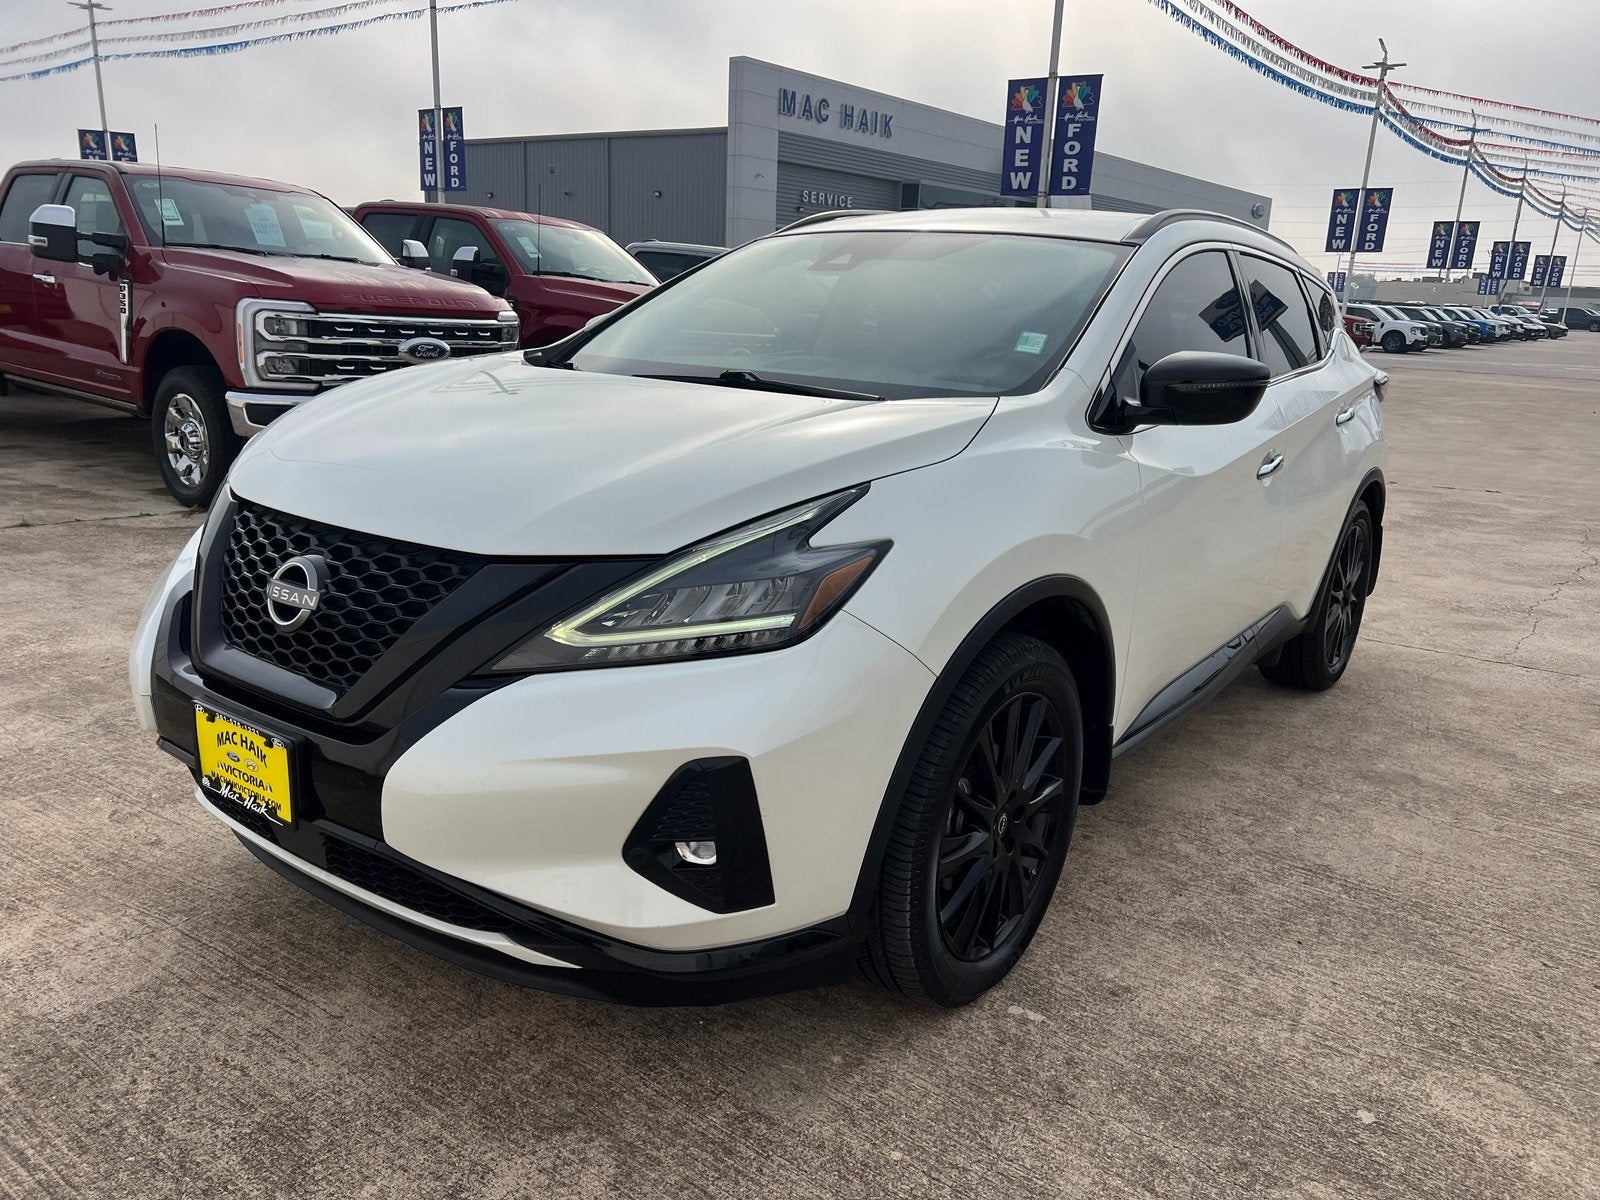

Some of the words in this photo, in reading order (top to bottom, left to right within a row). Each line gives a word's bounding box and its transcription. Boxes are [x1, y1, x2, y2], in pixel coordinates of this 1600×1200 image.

[779, 88, 830, 124] MAC
[841, 103, 894, 138] HAIK
[424, 141, 436, 187] NEW
[449, 141, 460, 188] FORD
[1010, 126, 1032, 190] NEW
[1061, 123, 1081, 190] FORD
[803, 190, 853, 208] SERVICE
[1332, 214, 1348, 249] NEW
[1364, 214, 1379, 250] FORD
[1431, 240, 1445, 267] NEW
[1457, 240, 1470, 268] FORD
[1492, 256, 1503, 278] NEW
[1513, 257, 1523, 278] FORD
[1533, 267, 1543, 286] NEW
[1551, 268, 1560, 286] FORD
[415, 344, 440, 358] Ford
[217, 731, 238, 748] MAC
[240, 733, 268, 768] HAIK
[222, 763, 266, 790] VICTORIA
[220, 783, 243, 803] Mac
